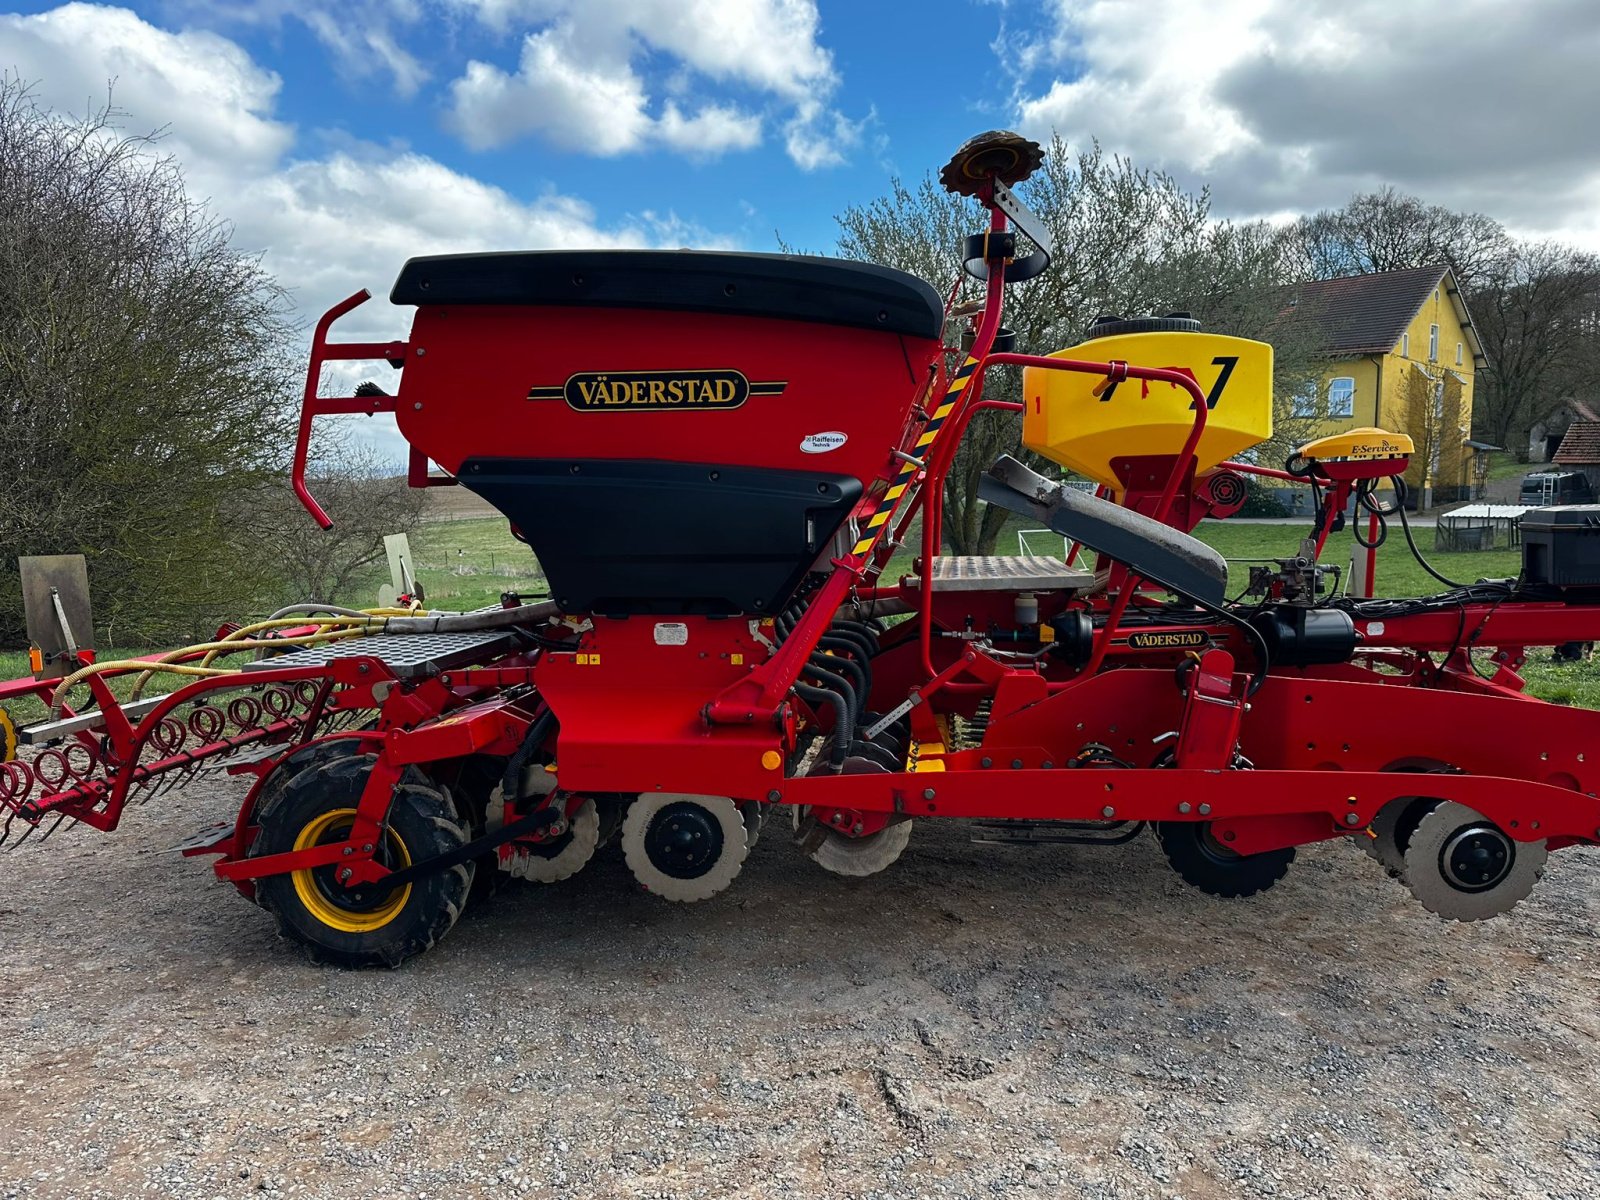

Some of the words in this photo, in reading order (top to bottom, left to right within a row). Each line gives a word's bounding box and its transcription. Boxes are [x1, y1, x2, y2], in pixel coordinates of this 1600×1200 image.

[577, 376, 737, 405] VÄDERSTAD
[812, 435, 844, 443] Raiffeisen
[1351, 444, 1399, 454] E-Services
[1135, 633, 1202, 647] VÄDERSTAD
